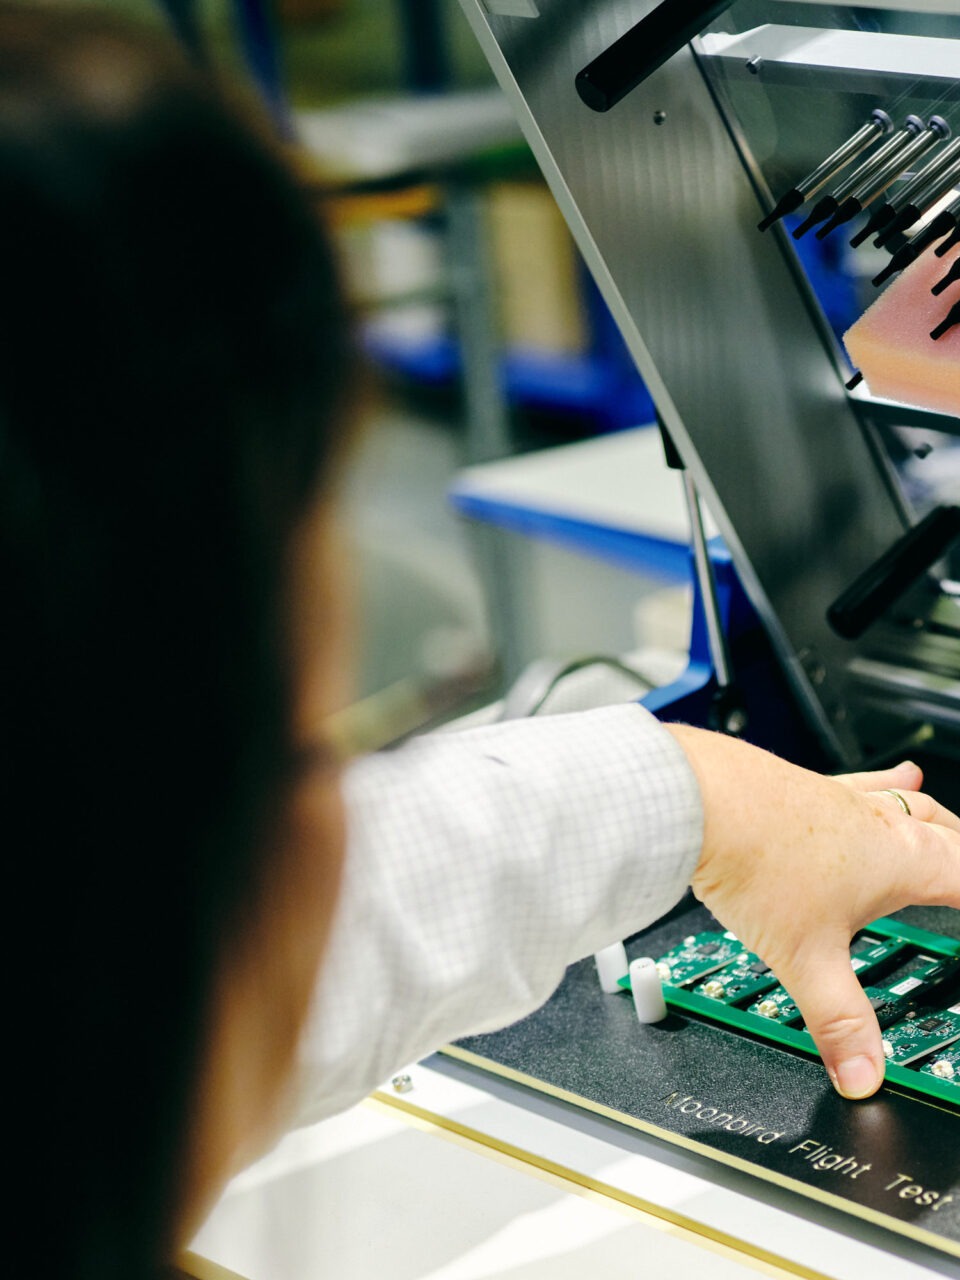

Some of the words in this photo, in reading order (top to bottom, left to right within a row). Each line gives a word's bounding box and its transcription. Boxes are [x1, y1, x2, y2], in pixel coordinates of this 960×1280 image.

[661, 1090, 785, 1144] Moonbird
[788, 1139, 872, 1179] Flight
[884, 1173, 953, 1211] Test
